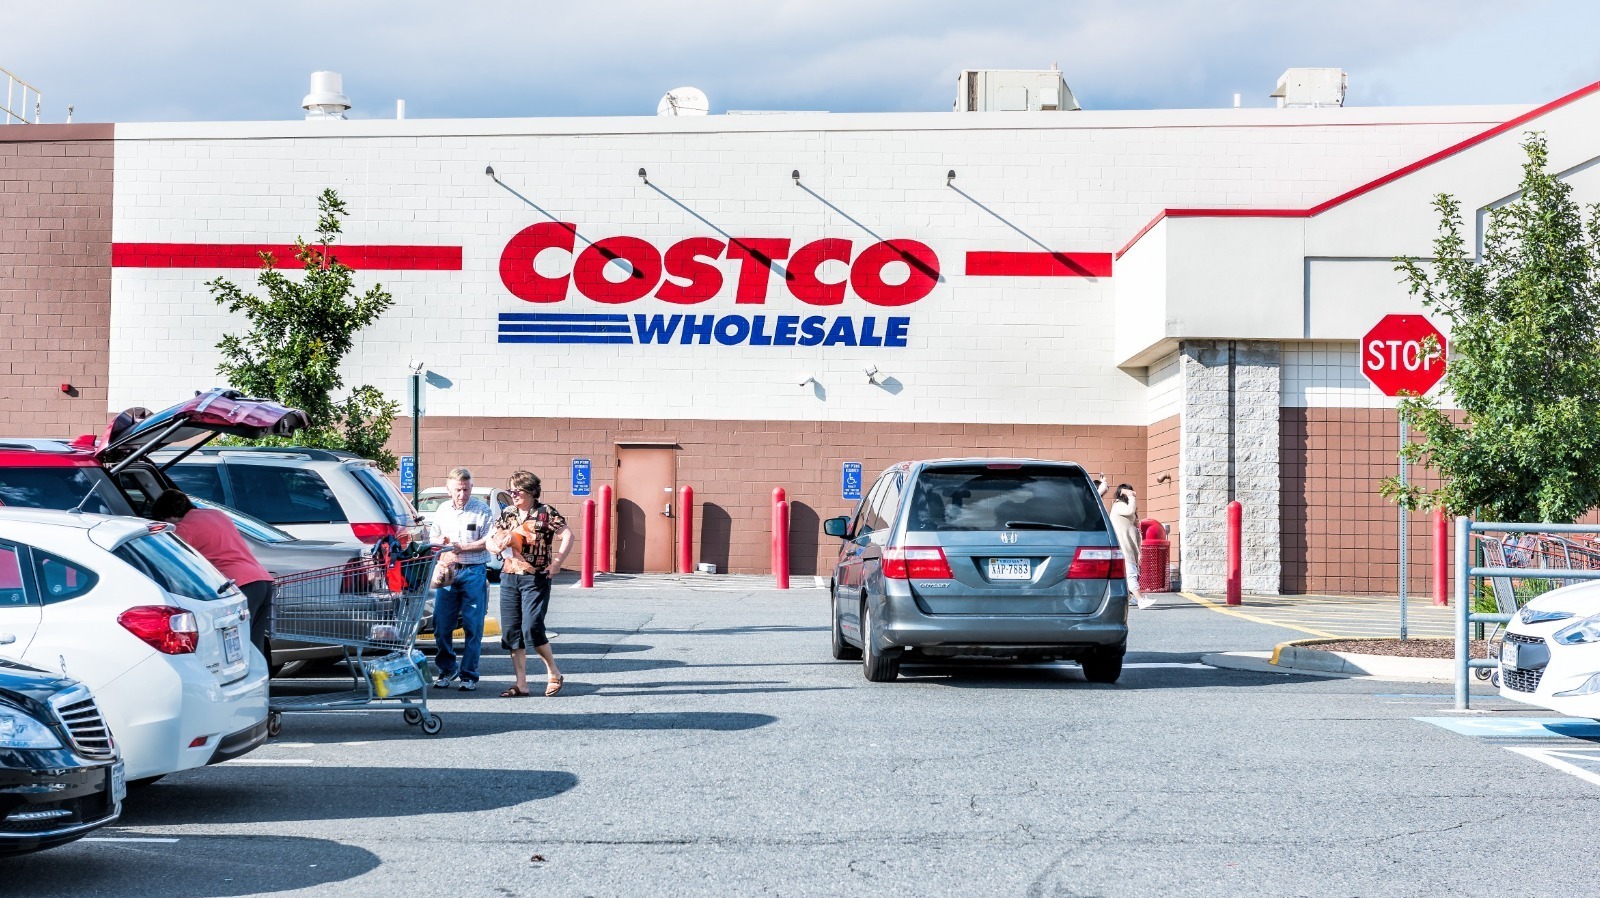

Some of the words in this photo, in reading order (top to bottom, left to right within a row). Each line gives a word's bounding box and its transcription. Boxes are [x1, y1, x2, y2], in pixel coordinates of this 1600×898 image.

[499, 221, 941, 306] COSTCO
[634, 314, 911, 347] WHOLESALE
[1367, 339, 1442, 371] STOP
